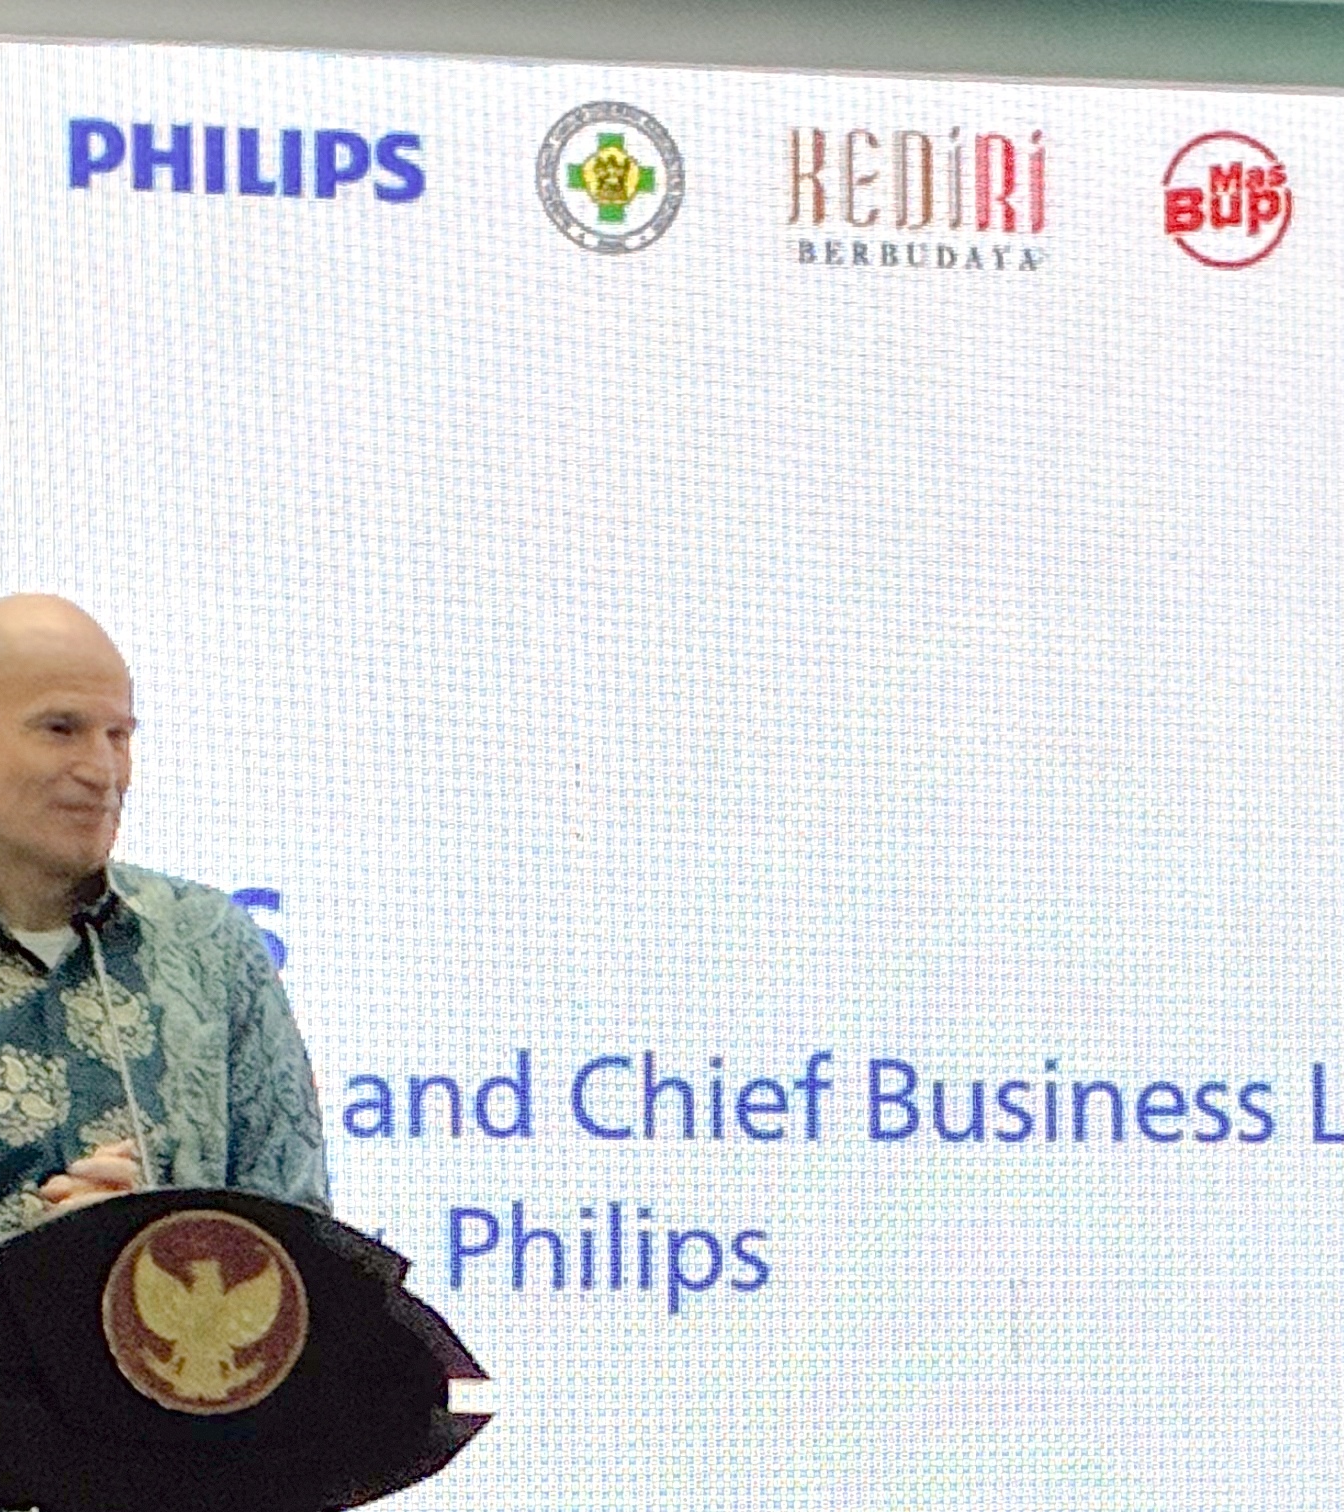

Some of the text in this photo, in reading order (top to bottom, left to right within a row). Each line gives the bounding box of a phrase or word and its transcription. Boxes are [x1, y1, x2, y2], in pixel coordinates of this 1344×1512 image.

[67, 117, 426, 204] PHILIPS
[797, 238, 1042, 271] BERBUDAYA
[342, 1051, 534, 1140] and
[570, 1049, 834, 1143] Chief
[867, 1056, 1277, 1144] Business
[449, 1200, 772, 1313] Philips
